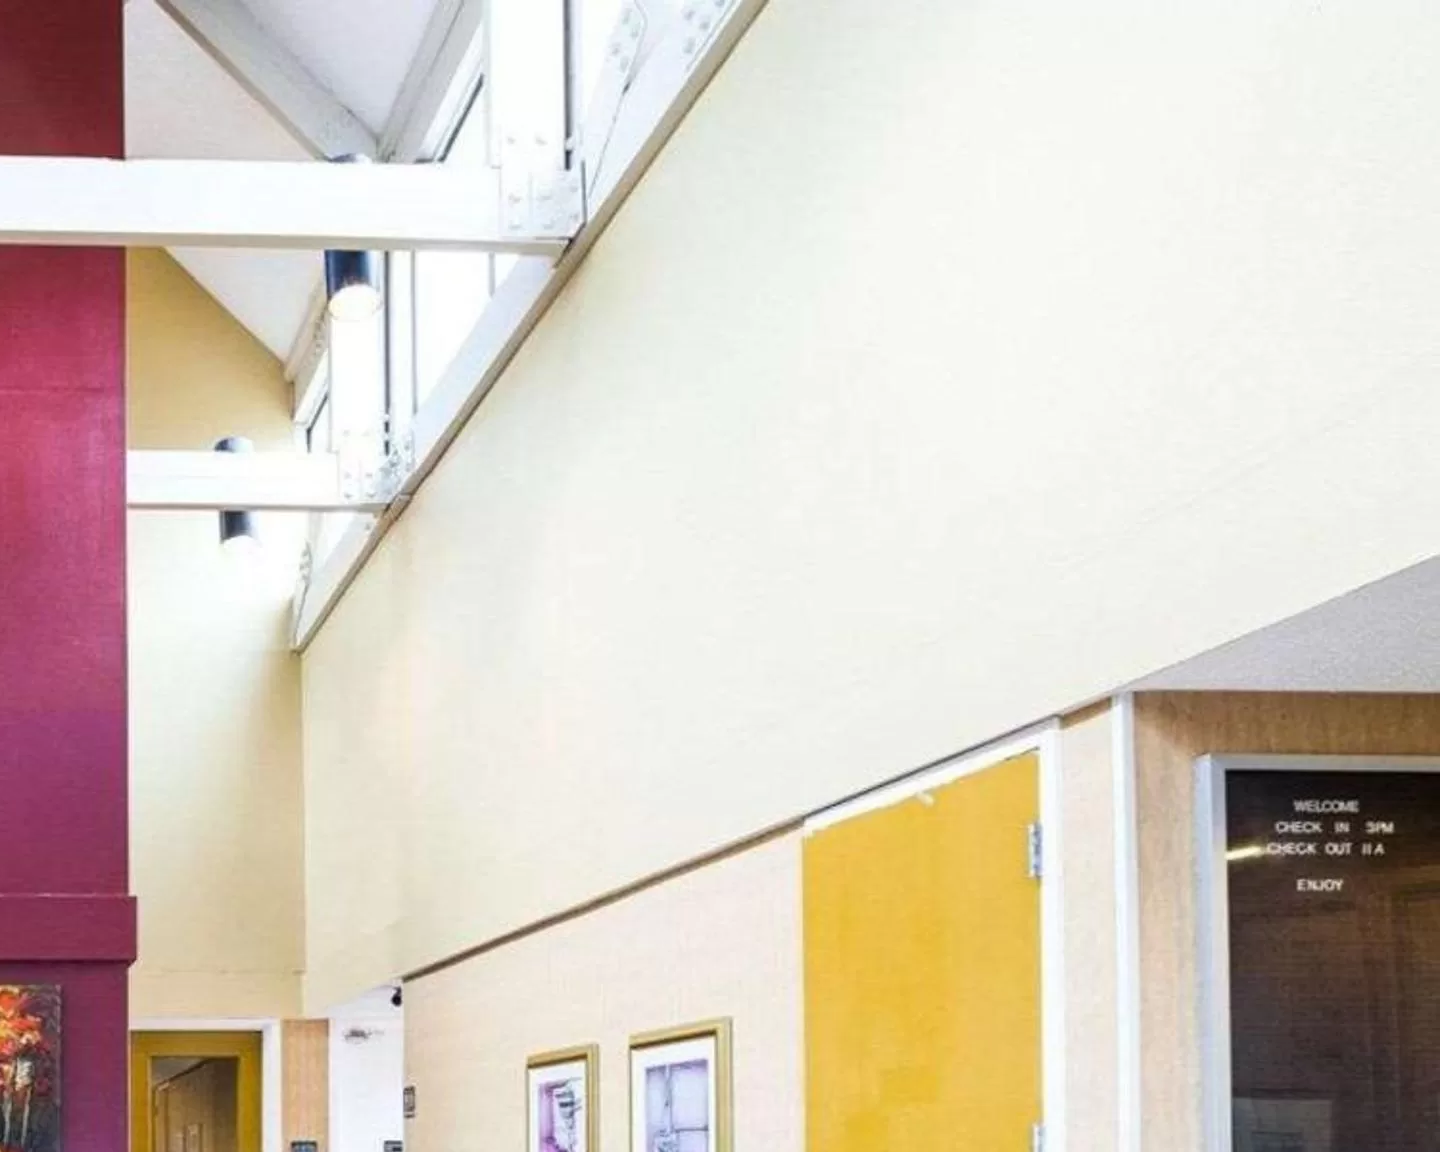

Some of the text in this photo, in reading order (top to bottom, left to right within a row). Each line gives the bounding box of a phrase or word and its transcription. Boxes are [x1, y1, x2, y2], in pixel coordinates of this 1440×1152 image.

[1293, 800, 1359, 812] WELCOME
[1275, 821, 1394, 833] CHECK IN 3PM
[1266, 842, 1317, 855] CHECK
[1325, 842, 1352, 855] OUT
[1296, 879, 1343, 891] ENJOY
